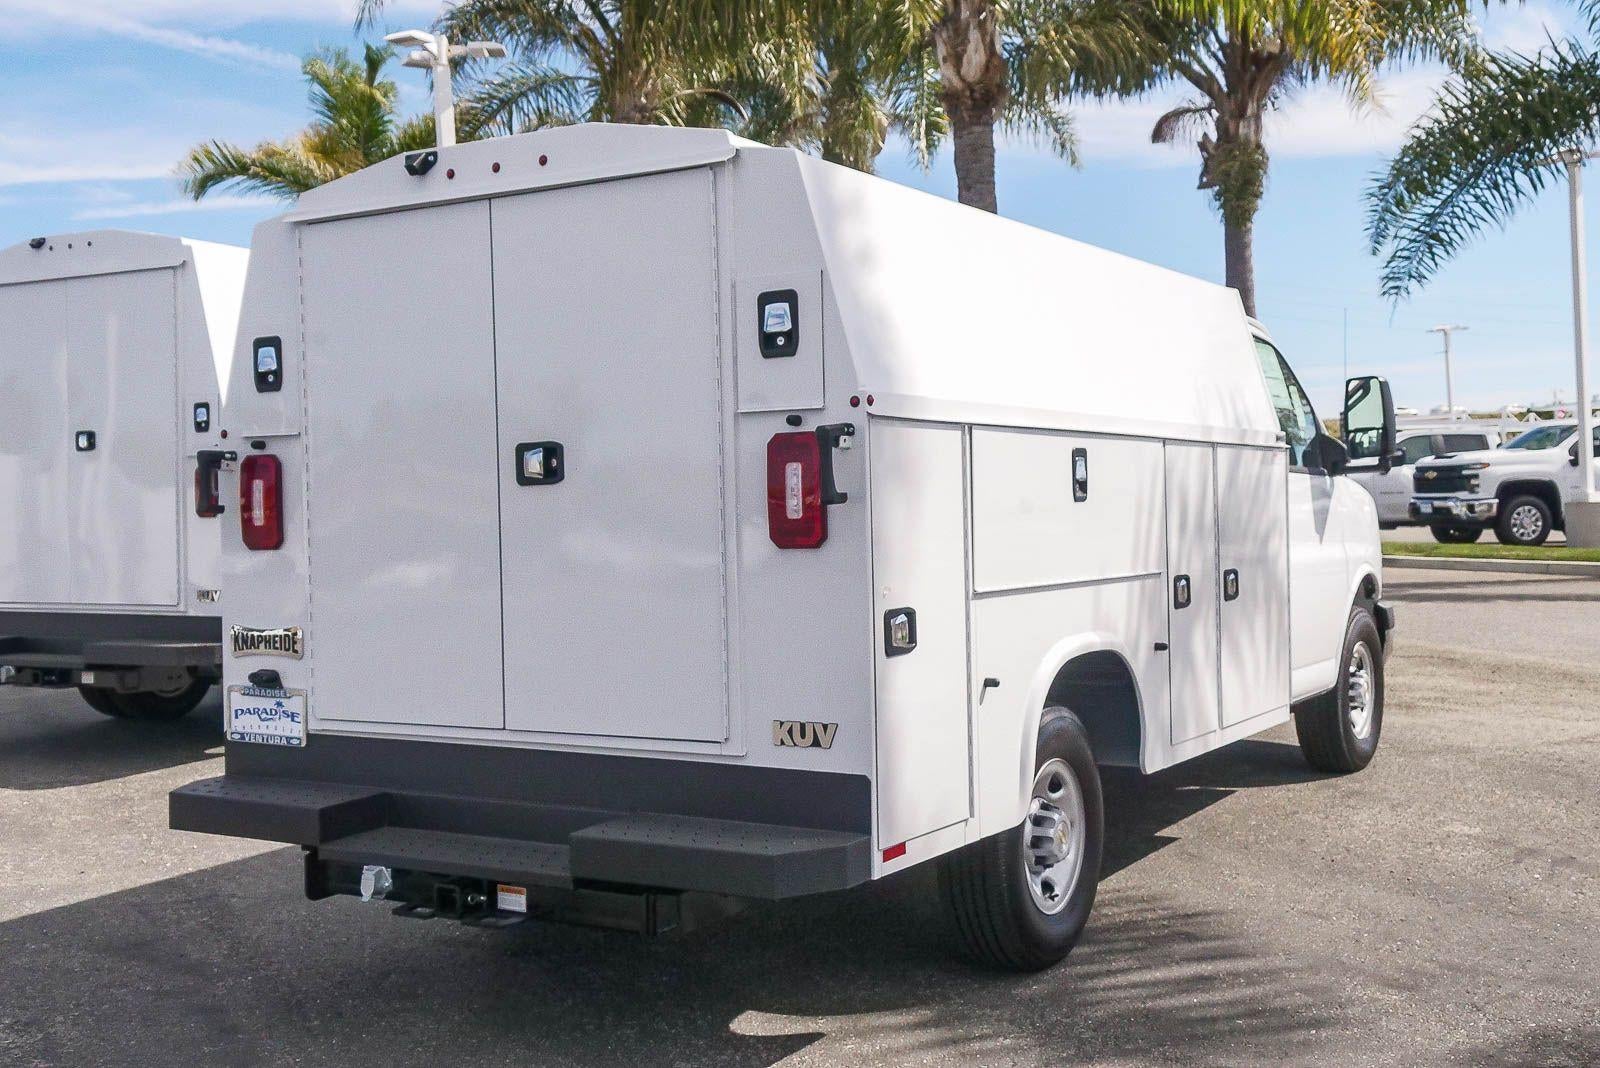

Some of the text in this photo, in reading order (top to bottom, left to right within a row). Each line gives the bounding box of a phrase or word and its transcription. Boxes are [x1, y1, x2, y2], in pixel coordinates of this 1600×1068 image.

[232, 631, 299, 654] KNAPHEIDE
[244, 687, 288, 698] PARADISE
[234, 704, 301, 724] PARADISE
[244, 732, 287, 745] VENTURA
[773, 719, 838, 749] KUV
